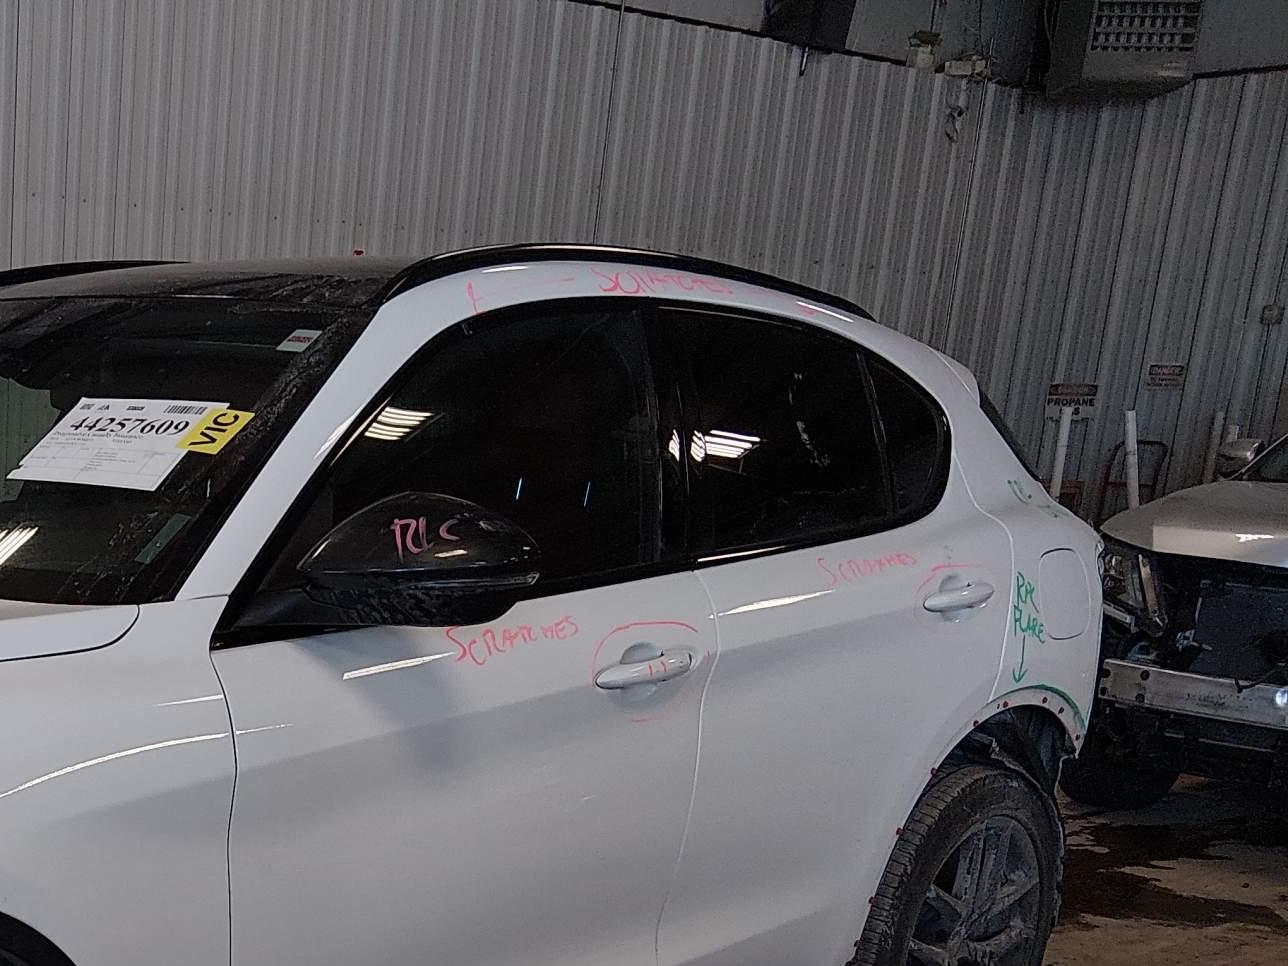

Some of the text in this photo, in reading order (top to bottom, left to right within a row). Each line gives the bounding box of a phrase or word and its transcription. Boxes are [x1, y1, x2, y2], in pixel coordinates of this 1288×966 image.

[1047, 397, 1095, 407] PROPANE
[69, 416, 190, 436] 44257609
[188, 412, 240, 448] VIC
